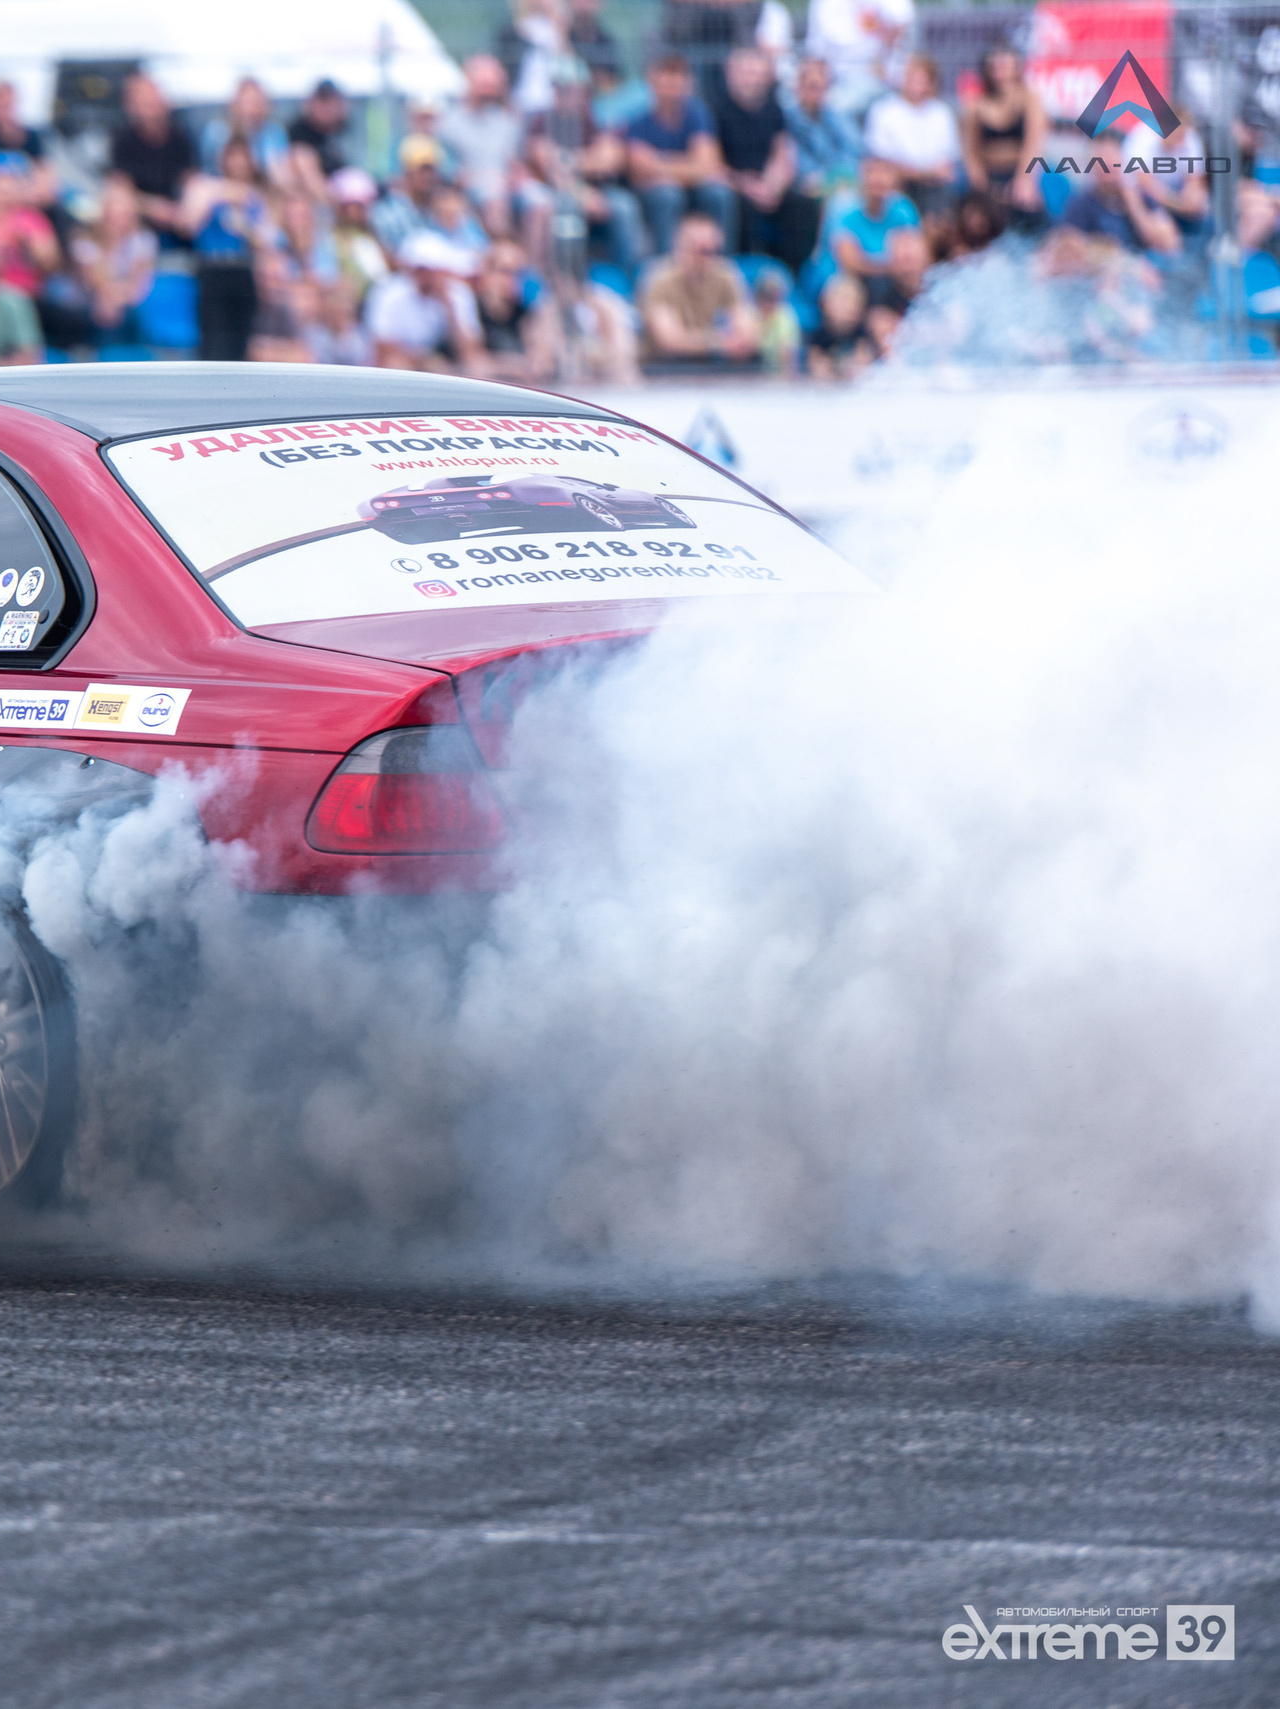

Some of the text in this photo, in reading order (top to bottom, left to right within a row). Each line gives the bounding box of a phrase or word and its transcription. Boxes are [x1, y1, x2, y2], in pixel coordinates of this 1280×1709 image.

[150, 418, 658, 461] УДАЛЕНИЕ ВМЯТИН
[258, 436, 620, 468] (БЕЗ ПОКРАСКИ)
[371, 455, 559, 472] www.hlopun.ru
[426, 540, 758, 570] 8 906 218 92 91
[455, 563, 783, 591] romanegorenko1982
[49, 701, 68, 719] 39
[141, 706, 172, 716] eurol
